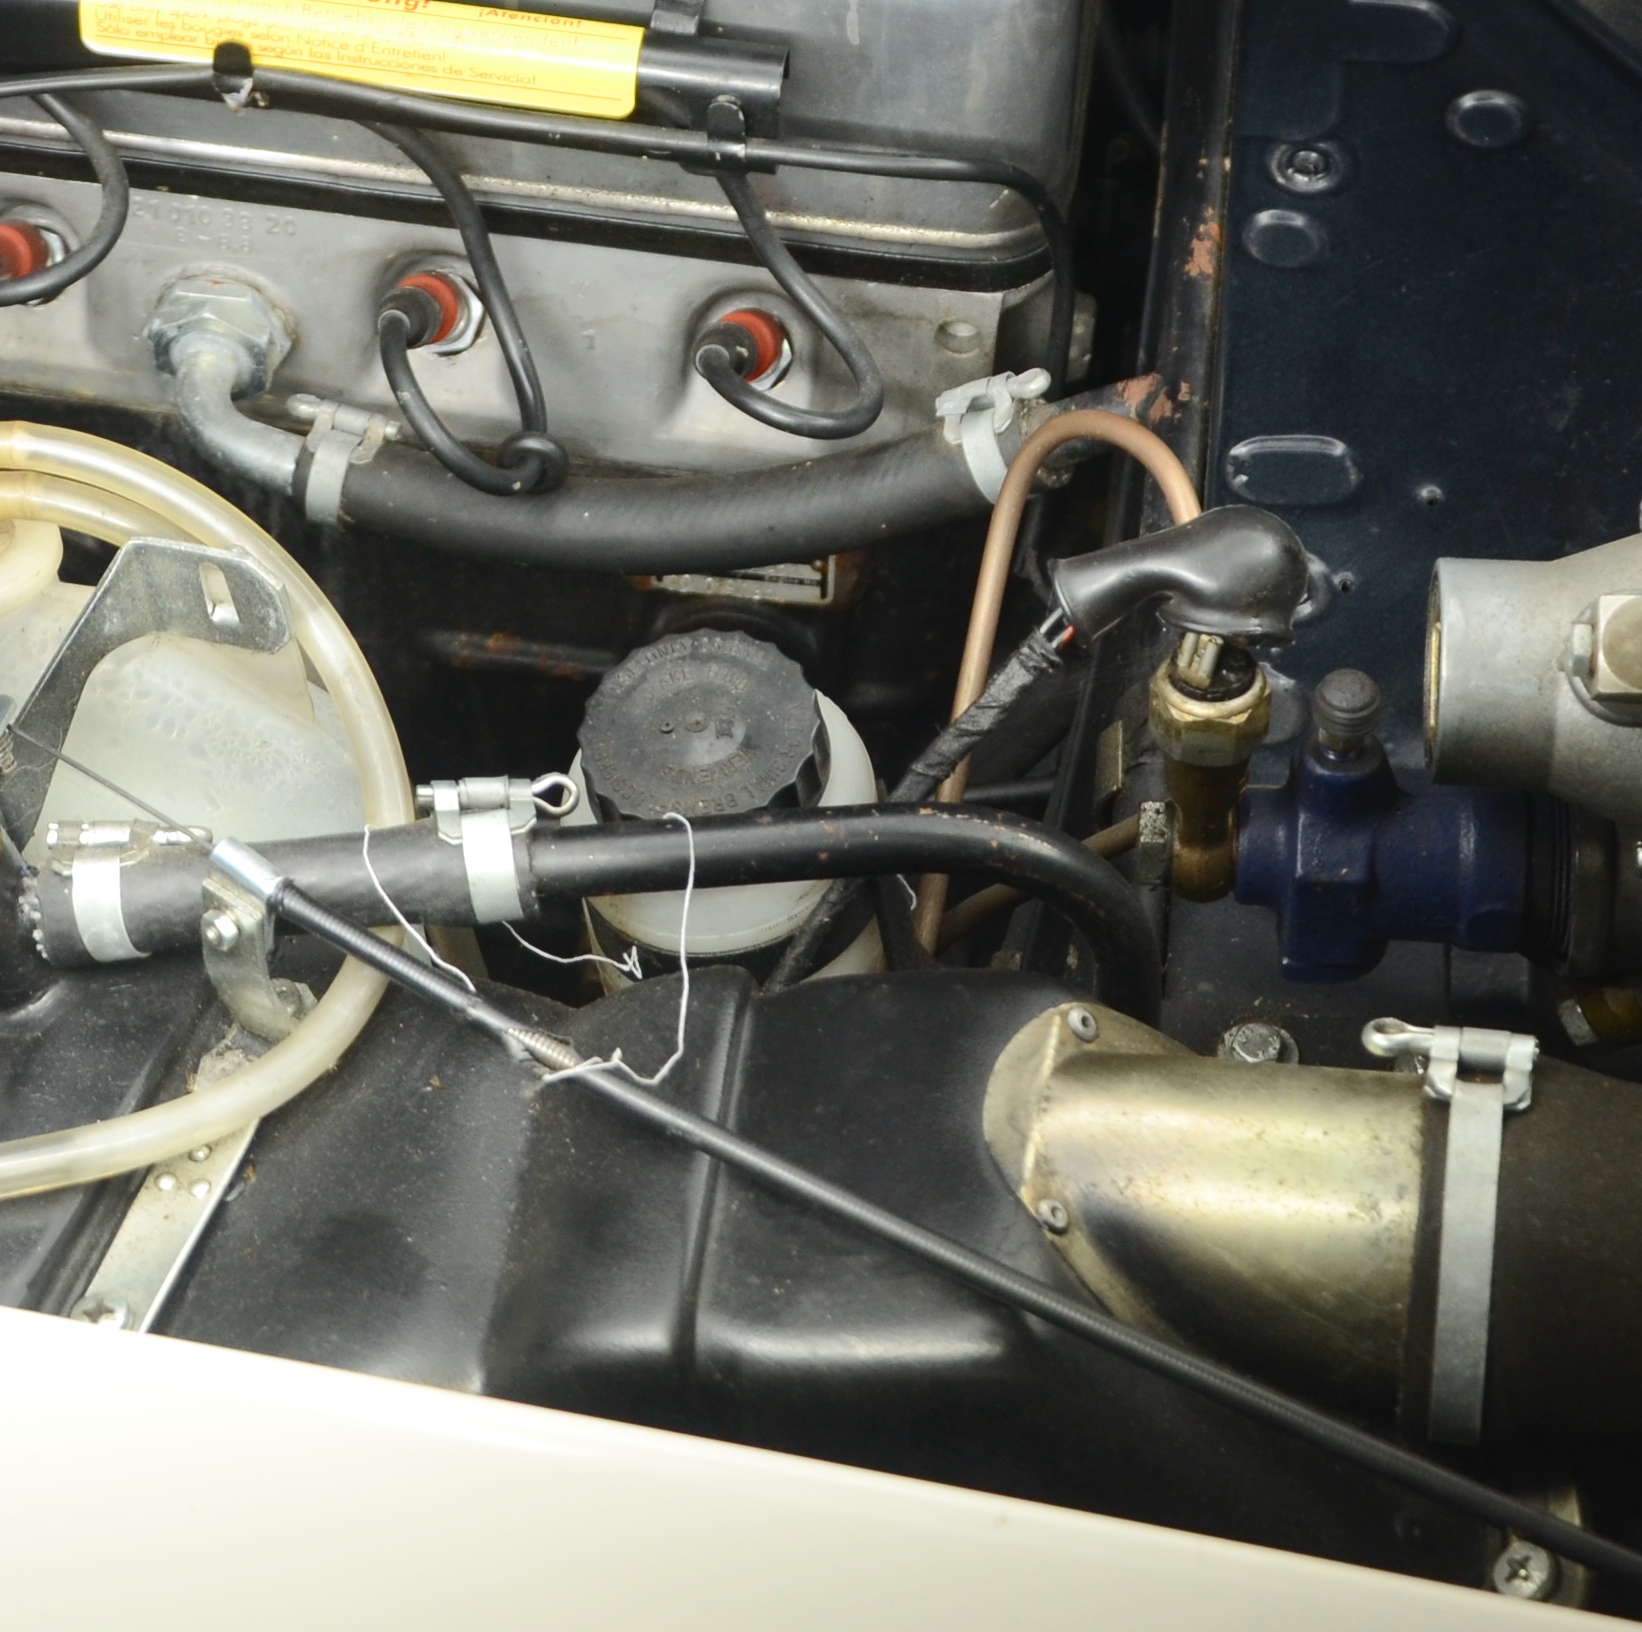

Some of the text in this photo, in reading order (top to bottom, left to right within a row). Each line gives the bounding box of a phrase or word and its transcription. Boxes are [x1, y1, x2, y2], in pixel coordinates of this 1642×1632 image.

[95, 7, 149, 27] Utiliser
[155, 10, 176, 30] les
[182, 16, 244, 38] bougies
[250, 26, 291, 44] selon
[296, 33, 350, 51] Notice
[136, 28, 198, 45] emplear
[309, 46, 332, 61] las
[337, 50, 439, 74] Instrucciones
[442, 63, 464, 77] de
[469, 66, 537, 86] Servicio!
